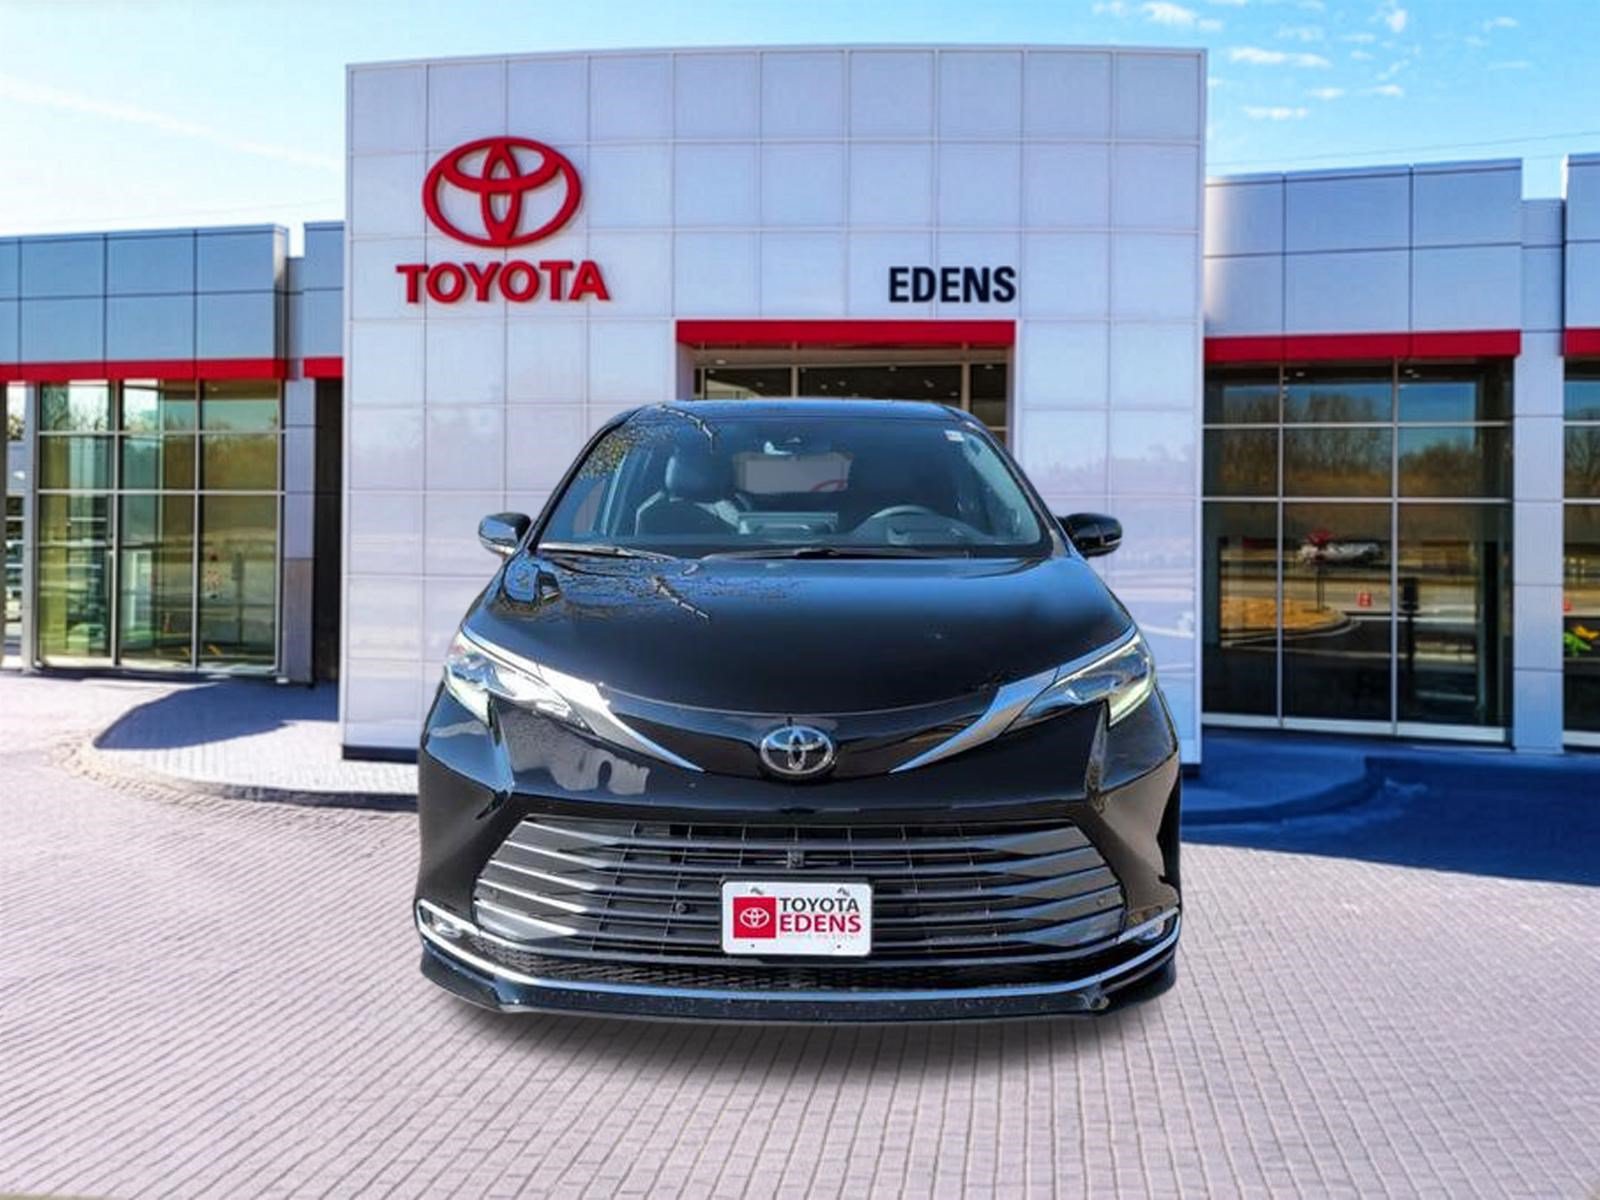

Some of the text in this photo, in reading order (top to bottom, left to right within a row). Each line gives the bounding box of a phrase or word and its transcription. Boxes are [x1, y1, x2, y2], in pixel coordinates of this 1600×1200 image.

[396, 259, 610, 304] TOYOTA
[889, 266, 1017, 303] EDENS
[779, 897, 860, 913] TOYOTA
[780, 914, 862, 933] EDENS
